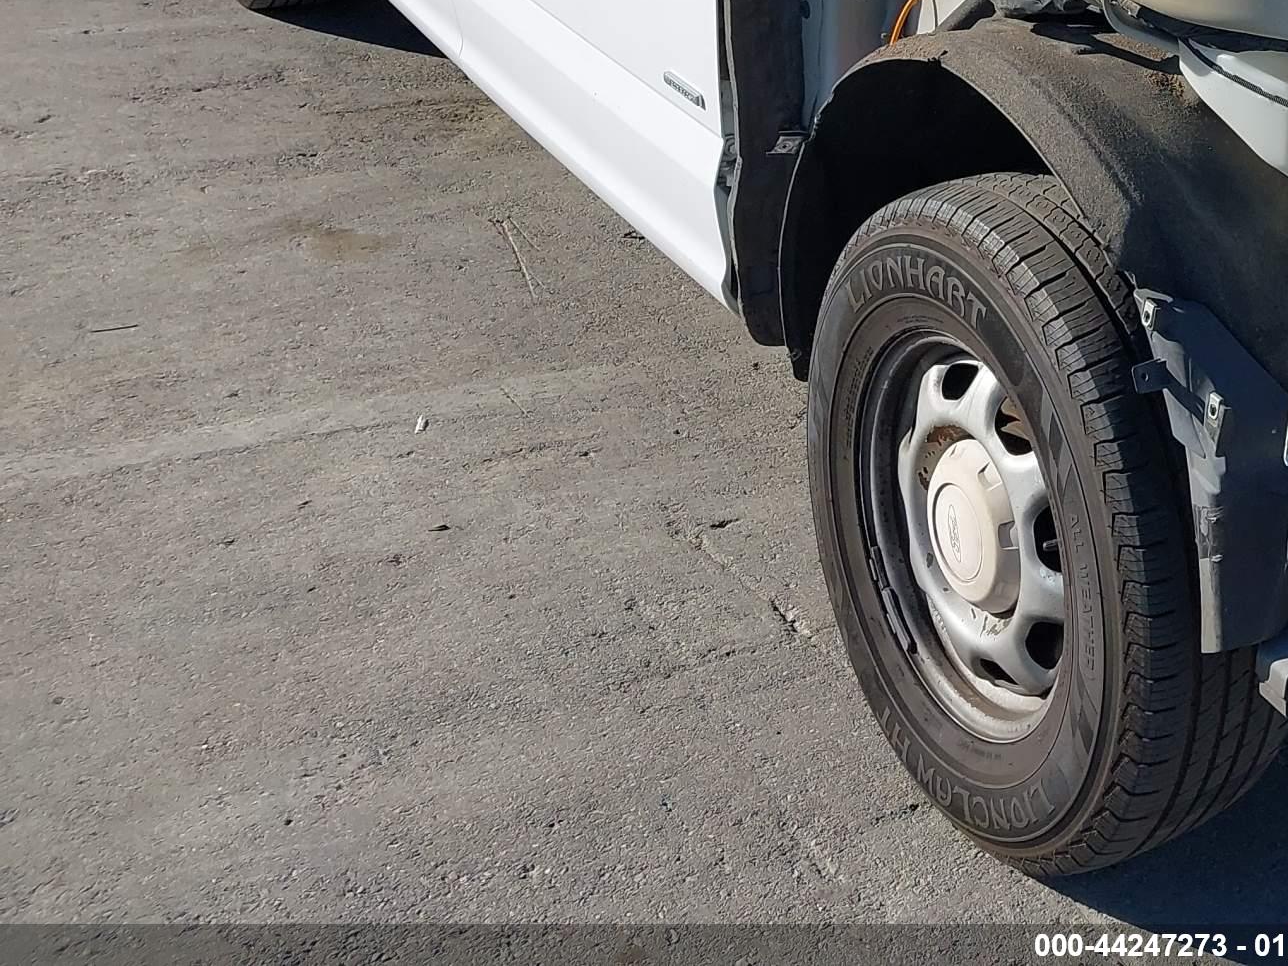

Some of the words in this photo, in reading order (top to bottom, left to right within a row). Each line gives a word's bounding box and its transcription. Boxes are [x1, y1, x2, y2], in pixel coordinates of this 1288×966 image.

[845, 256, 991, 330] LIONHART
[1071, 514, 1084, 554] ALL
[1078, 563, 1097, 681] WEATHER
[879, 705, 914, 755] HT
[916, 754, 1058, 829] LIONCLAW
